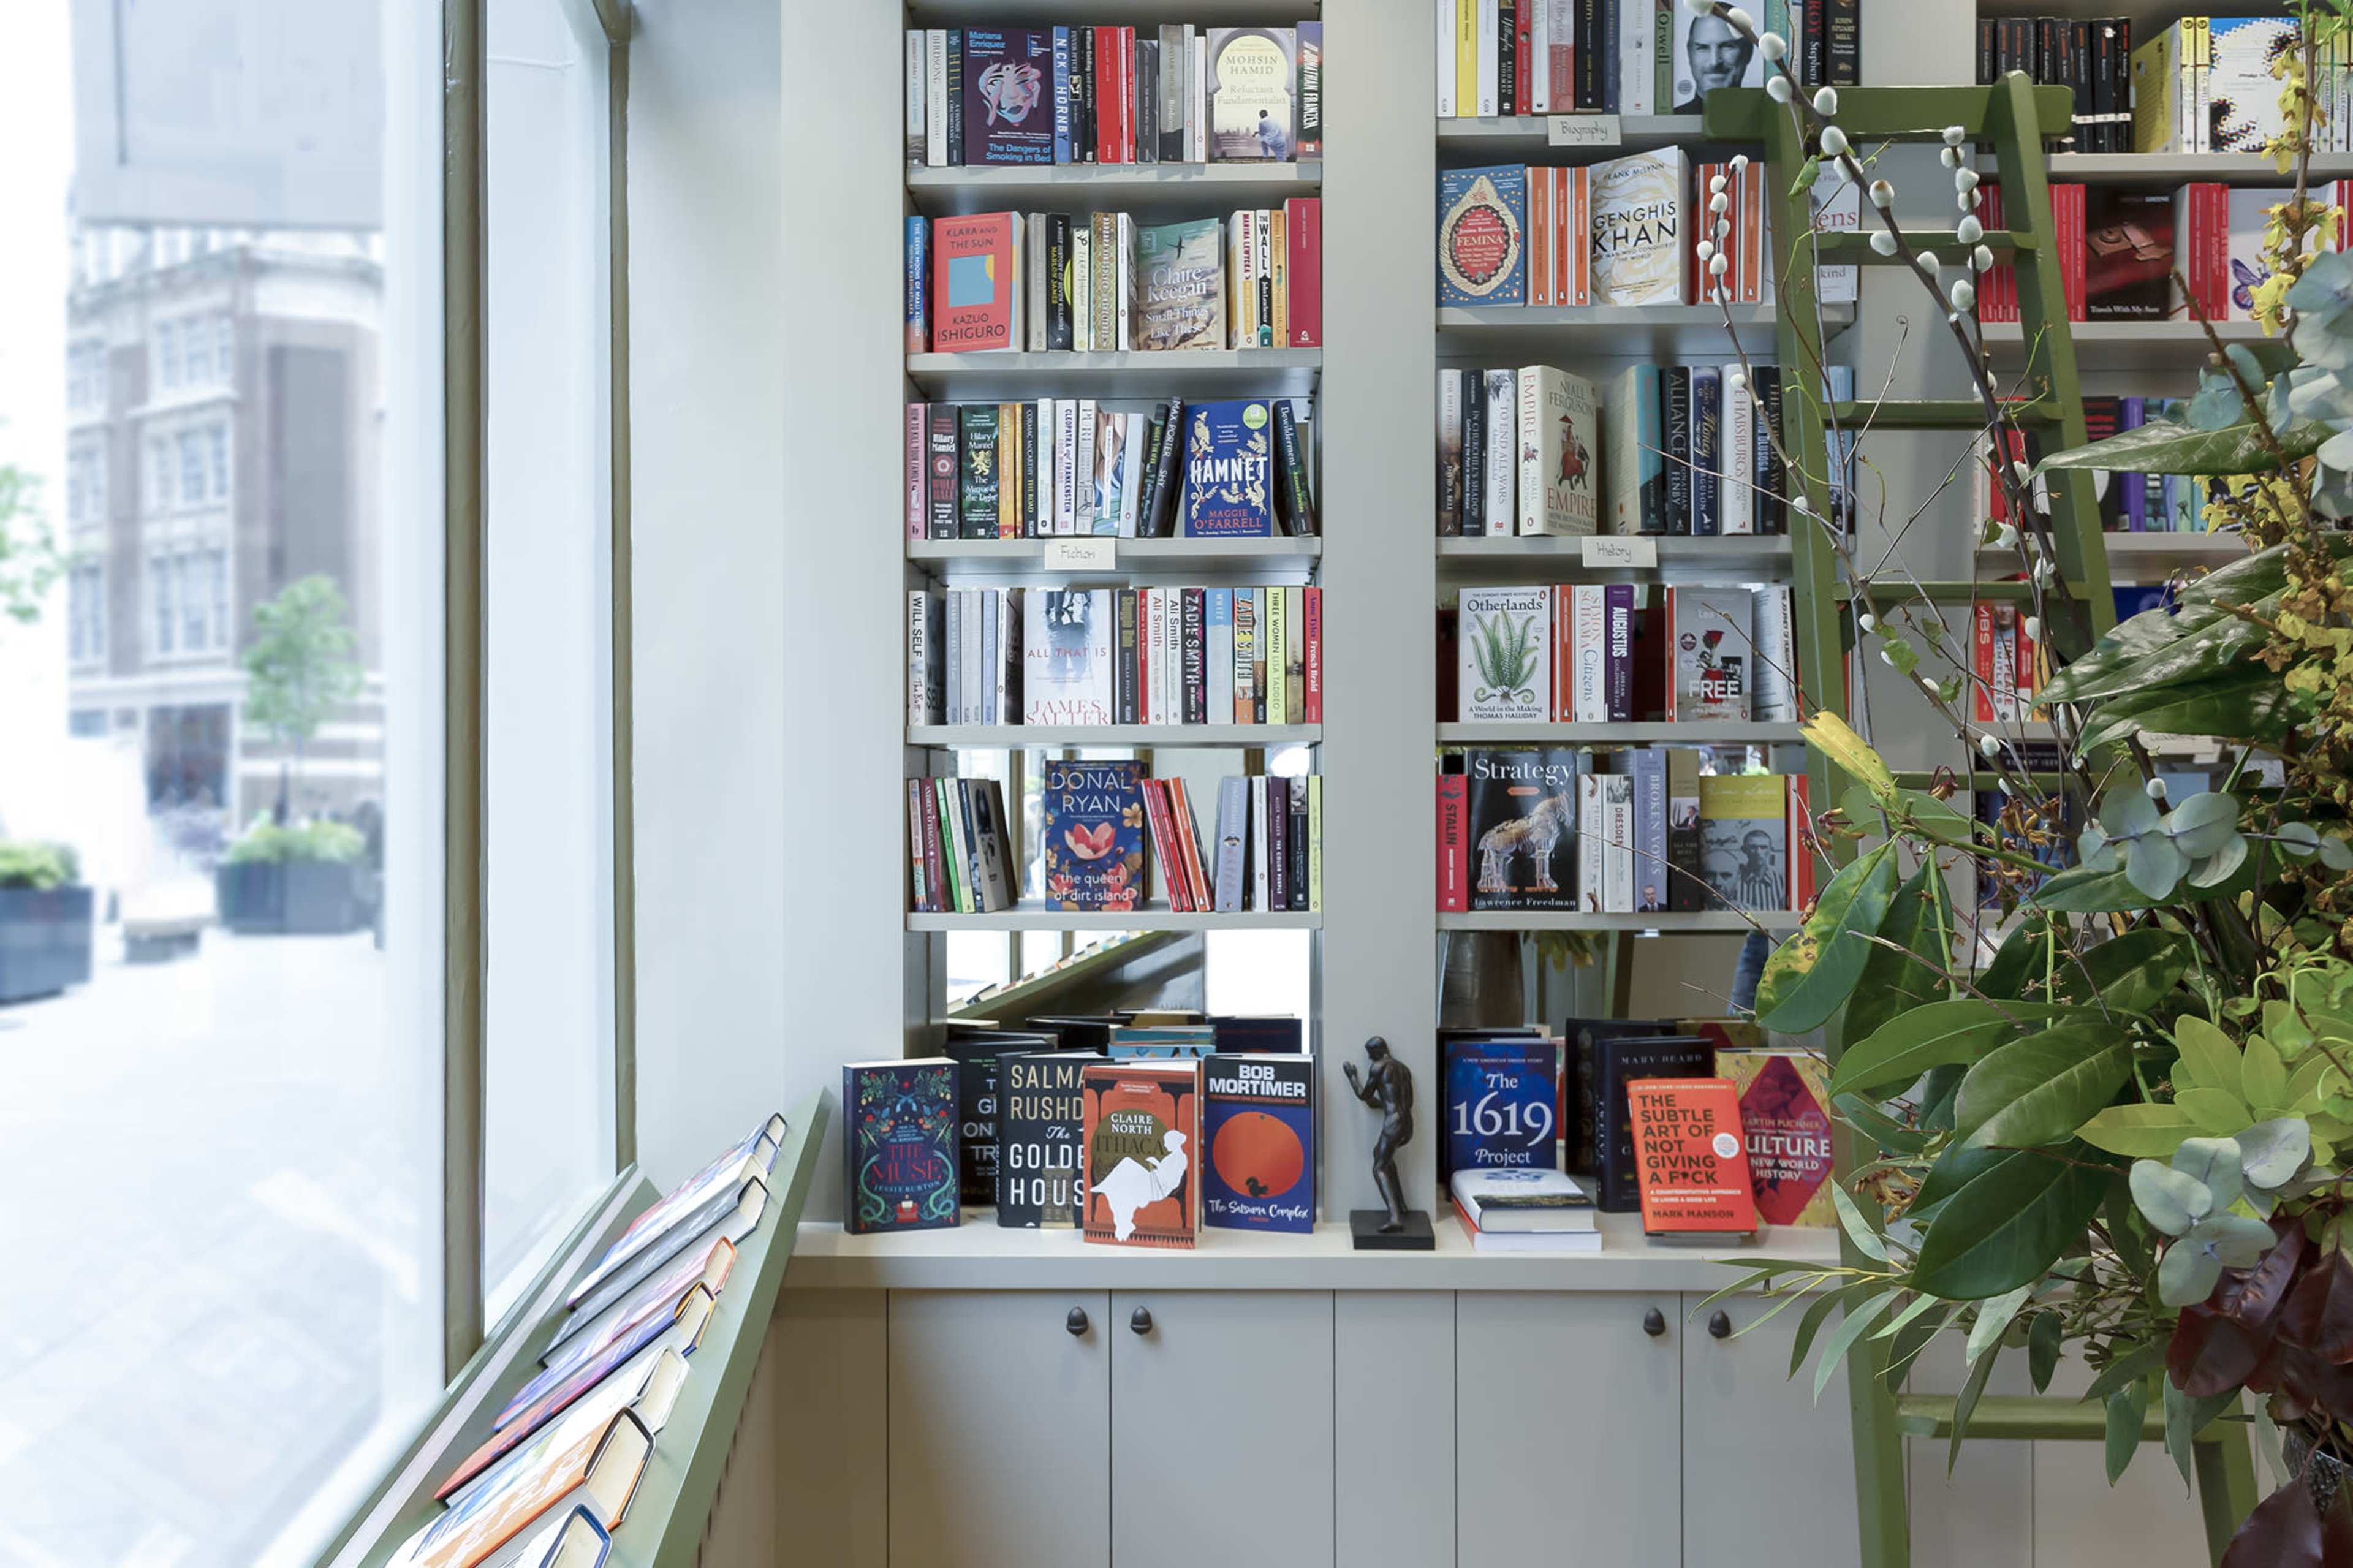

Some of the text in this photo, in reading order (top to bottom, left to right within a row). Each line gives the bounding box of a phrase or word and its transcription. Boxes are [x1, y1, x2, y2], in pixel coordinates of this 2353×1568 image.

[969, 31, 1002, 40] Mariana
[969, 39, 1006, 49] Enriquez
[1658, 13, 1670, 64] Orwell
[932, 35, 942, 84] BIRDSONG
[1226, 55, 1278, 65] MOHSIN
[1808, 40, 1820, 79] Stephen
[1230, 65, 1274, 75] HAMID
[1056, 38, 1067, 141] NICK HORNBY
[1217, 96, 1286, 105] Fundamentalist
[1561, 121, 1608, 142] Biography
[987, 152, 1022, 162] Smoking
[989, 143, 1004, 152] The
[1006, 144, 1040, 154] Dangers
[1594, 201, 1676, 230] GENGHIS
[947, 227, 977, 237] KLARA
[1457, 235, 1503, 246] FEMINA
[1593, 218, 1677, 254] KHAN
[950, 238, 993, 249] THE SUN
[1259, 224, 1269, 270] WALL
[1152, 266, 1202, 286] Claire
[1147, 281, 1207, 302] Keegan
[953, 313, 989, 324] KAZUO
[1146, 306, 1208, 324] Small Things
[937, 324, 1006, 342] ISHIGURO
[1150, 322, 1202, 339] Like These
[1560, 381, 1586, 394] NIALL
[1523, 374, 1536, 438] EMPIRE
[1548, 392, 1594, 414] FERGUSON
[1670, 374, 1685, 454] ALLIANCE
[970, 433, 991, 442] Hilary
[1280, 406, 1296, 466] Bewilderment
[1694, 406, 1716, 458] Money
[1734, 400, 1746, 478] HABSBURGS
[968, 441, 994, 450] Mantel
[1158, 400, 1181, 488] MAX PORTER SHY
[1499, 406, 1510, 505] TO END WARS
[1190, 456, 1268, 484] HAMNET
[974, 475, 988, 484] The
[1672, 471, 1680, 505] FENBY
[1471, 480, 1480, 518] SHADOW
[1547, 487, 1596, 518] EMPIRE
[1208, 509, 1248, 518] MAGGIE
[1194, 517, 1264, 530] O'FARRELL
[1059, 545, 1096, 559] Fiction
[1596, 542, 1632, 562] History
[1468, 598, 1543, 613] Otherlands
[912, 596, 922, 657] WILL SELF
[1153, 597, 1162, 647] Ali Smith
[1170, 600, 1179, 650] Ali Smith
[1580, 589, 1589, 648] SCHAMA
[1591, 596, 1601, 642] SIMON
[1186, 596, 1199, 684] ZADIE SMITH
[1237, 597, 1253, 680] ZADIE SMITH
[1612, 606, 1628, 657] AUGUSTUS
[1028, 647, 1107, 658] ALL THAT IS
[2004, 637, 2014, 659] TIM
[1583, 648, 1599, 702] Citizens
[1271, 676, 1281, 710] TADDEO
[1688, 680, 1740, 698] FREE
[1033, 700, 1101, 714] JAMES
[1026, 711, 1108, 725] SALTER
[1474, 757, 1576, 786] Strategy
[1051, 772, 1131, 790] DONAL
[1061, 795, 1121, 813] RYAN
[1446, 803, 1458, 845] STALIN
[1650, 775, 1660, 875] BROKEN VOWS
[1060, 873, 1123, 887] the queen
[1054, 888, 1129, 901] of dirt island
[1474, 896, 1577, 909] Lawrence Freedman
[1621, 1054, 1703, 1064] MARY BEARD
[1011, 1064, 1085, 1089] SALMA
[1238, 1064, 1275, 1080] BOB
[1485, 1072, 1519, 1089] The
[1208, 1078, 1306, 1097] MORTIMER
[1010, 1096, 1085, 1121] RUSHD
[1638, 1094, 1676, 1107] THE
[1110, 1112, 1153, 1124] CLAIRE
[1452, 1091, 1552, 1147] 1619
[1640, 1108, 1715, 1123] SUBTLE
[1778, 1119, 1820, 1128] PUCHNER
[1045, 1125, 1071, 1140] The
[1112, 1124, 1153, 1134] NORTH
[1643, 1124, 1715, 1138] ART OF
[887, 1143, 927, 1159] THE
[1095, 1135, 1165, 1156] ITHACA
[1645, 1140, 1685, 1153] NOT
[1745, 1134, 1831, 1157] ULTURE
[1474, 1148, 1531, 1167] Project
[1646, 1154, 1716, 1169] GIVING
[1751, 1158, 1819, 1170] NEW WORLD
[870, 1158, 942, 1184] MUSE
[1648, 1172, 1663, 1185] A
[1755, 1169, 1801, 1180] HISTORY
[874, 1180, 941, 1193] JESSIE BURTON
[1010, 1178, 1085, 1206] HOUS
[1208, 1199, 1309, 1221] The Satsuma Complex
[1653, 1209, 1734, 1218] MARK MANSON
